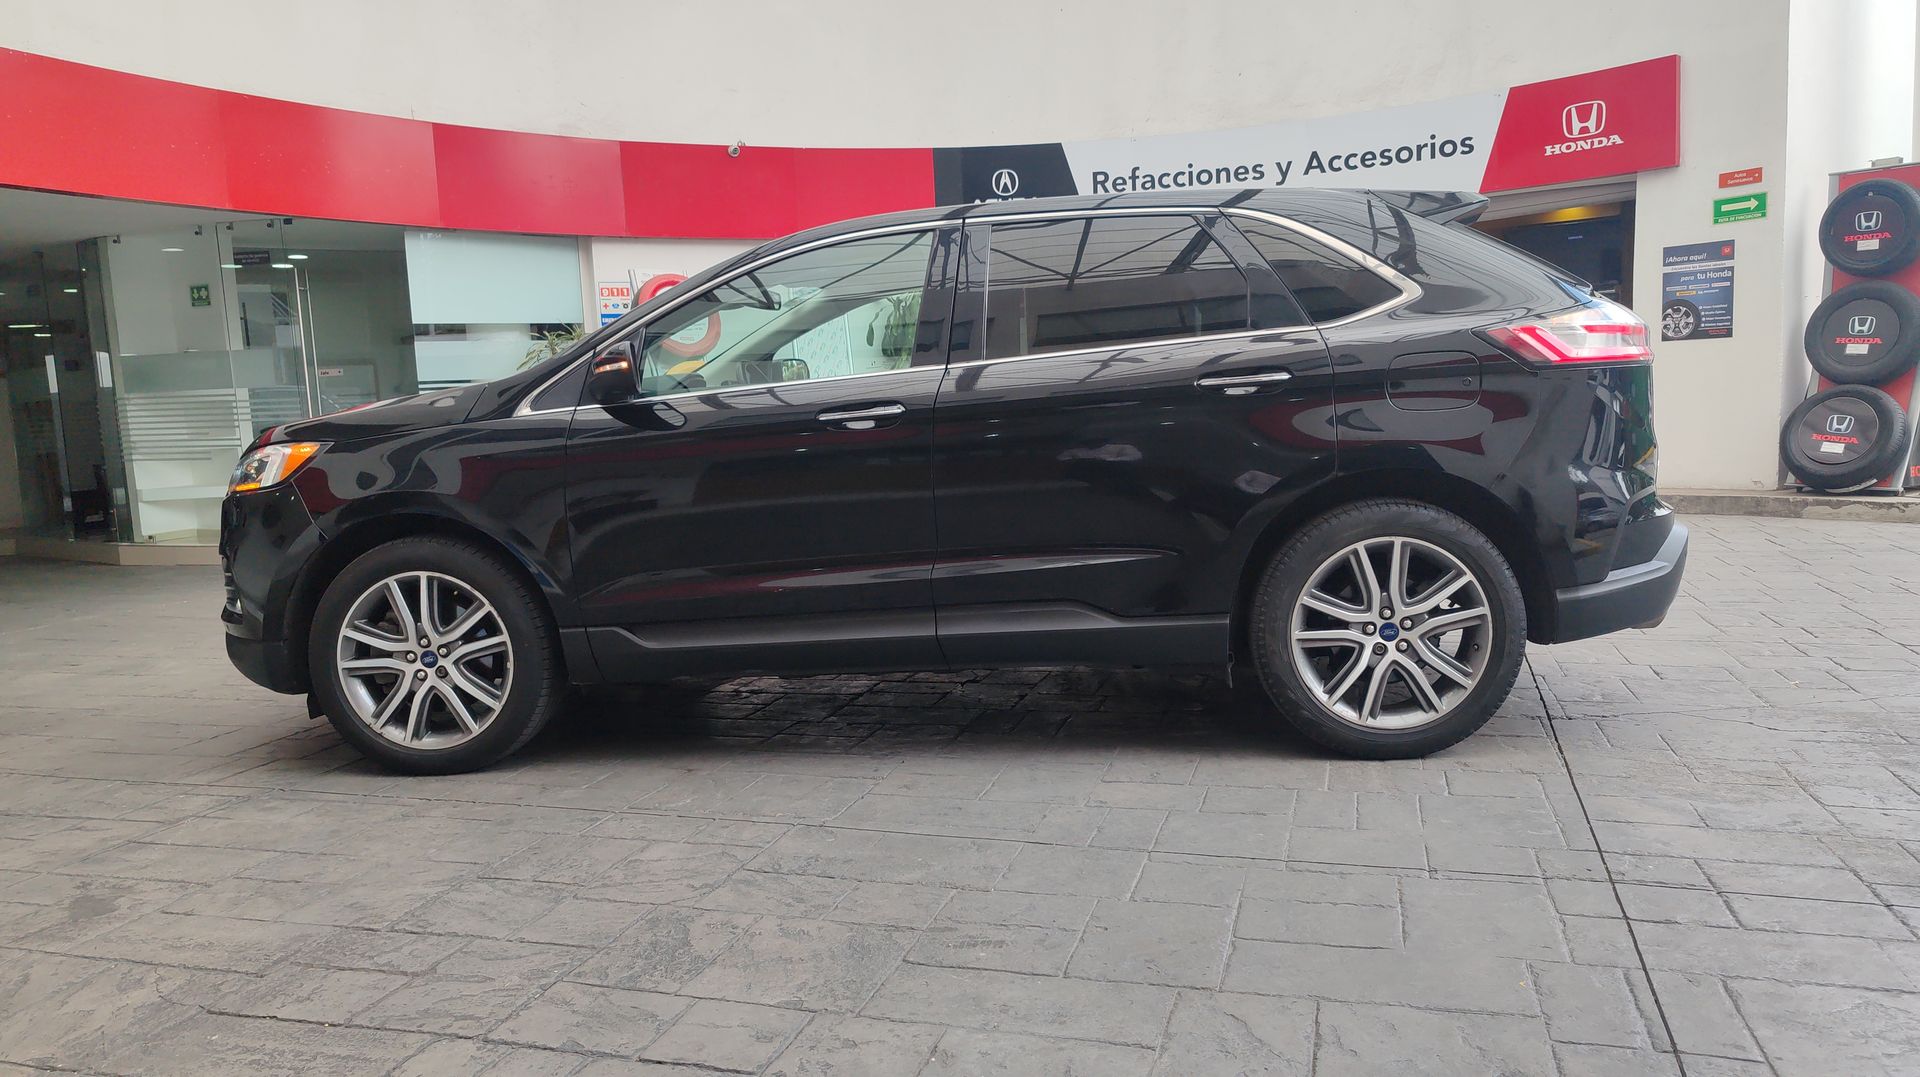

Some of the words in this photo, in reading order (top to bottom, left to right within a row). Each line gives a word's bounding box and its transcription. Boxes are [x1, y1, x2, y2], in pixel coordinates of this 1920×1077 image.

[1544, 135, 1624, 156] HONDA
[1092, 163, 1265, 194] Refacciones
[1275, 160, 1292, 186] y
[1303, 134, 1475, 176] Accesorios
[1844, 232, 1892, 242] HONDA
[1697, 272, 1706, 280] tu
[1707, 270, 1732, 279] Honda
[601, 288, 629, 297] 911
[1811, 433, 1859, 444] HONDA
